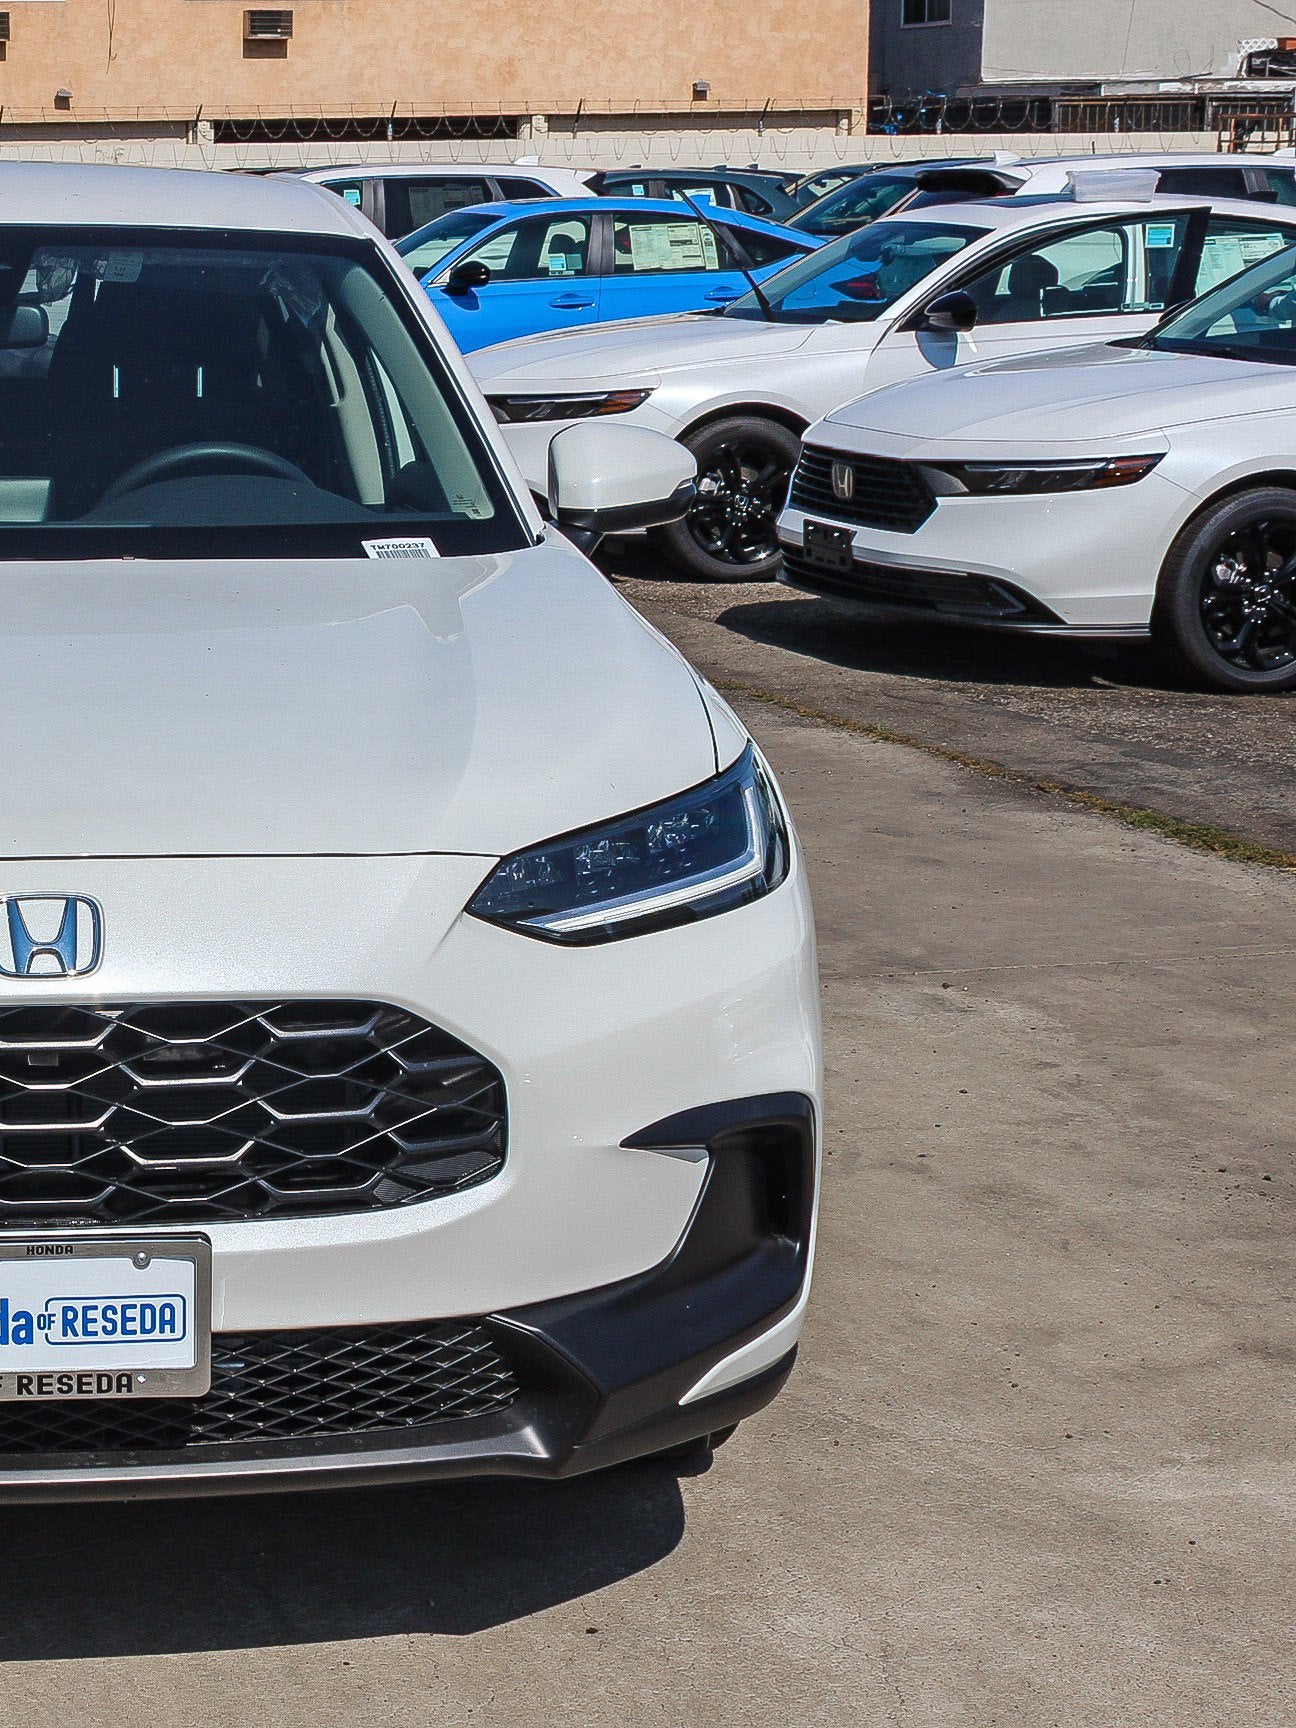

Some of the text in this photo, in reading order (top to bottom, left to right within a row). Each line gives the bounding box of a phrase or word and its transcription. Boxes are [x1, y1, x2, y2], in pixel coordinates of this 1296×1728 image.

[26, 1244, 74, 1256] HONDA
[36, 1312, 56, 1331] OF
[61, 1302, 176, 1338] RESEDA
[16, 1372, 134, 1397] RESEDA
